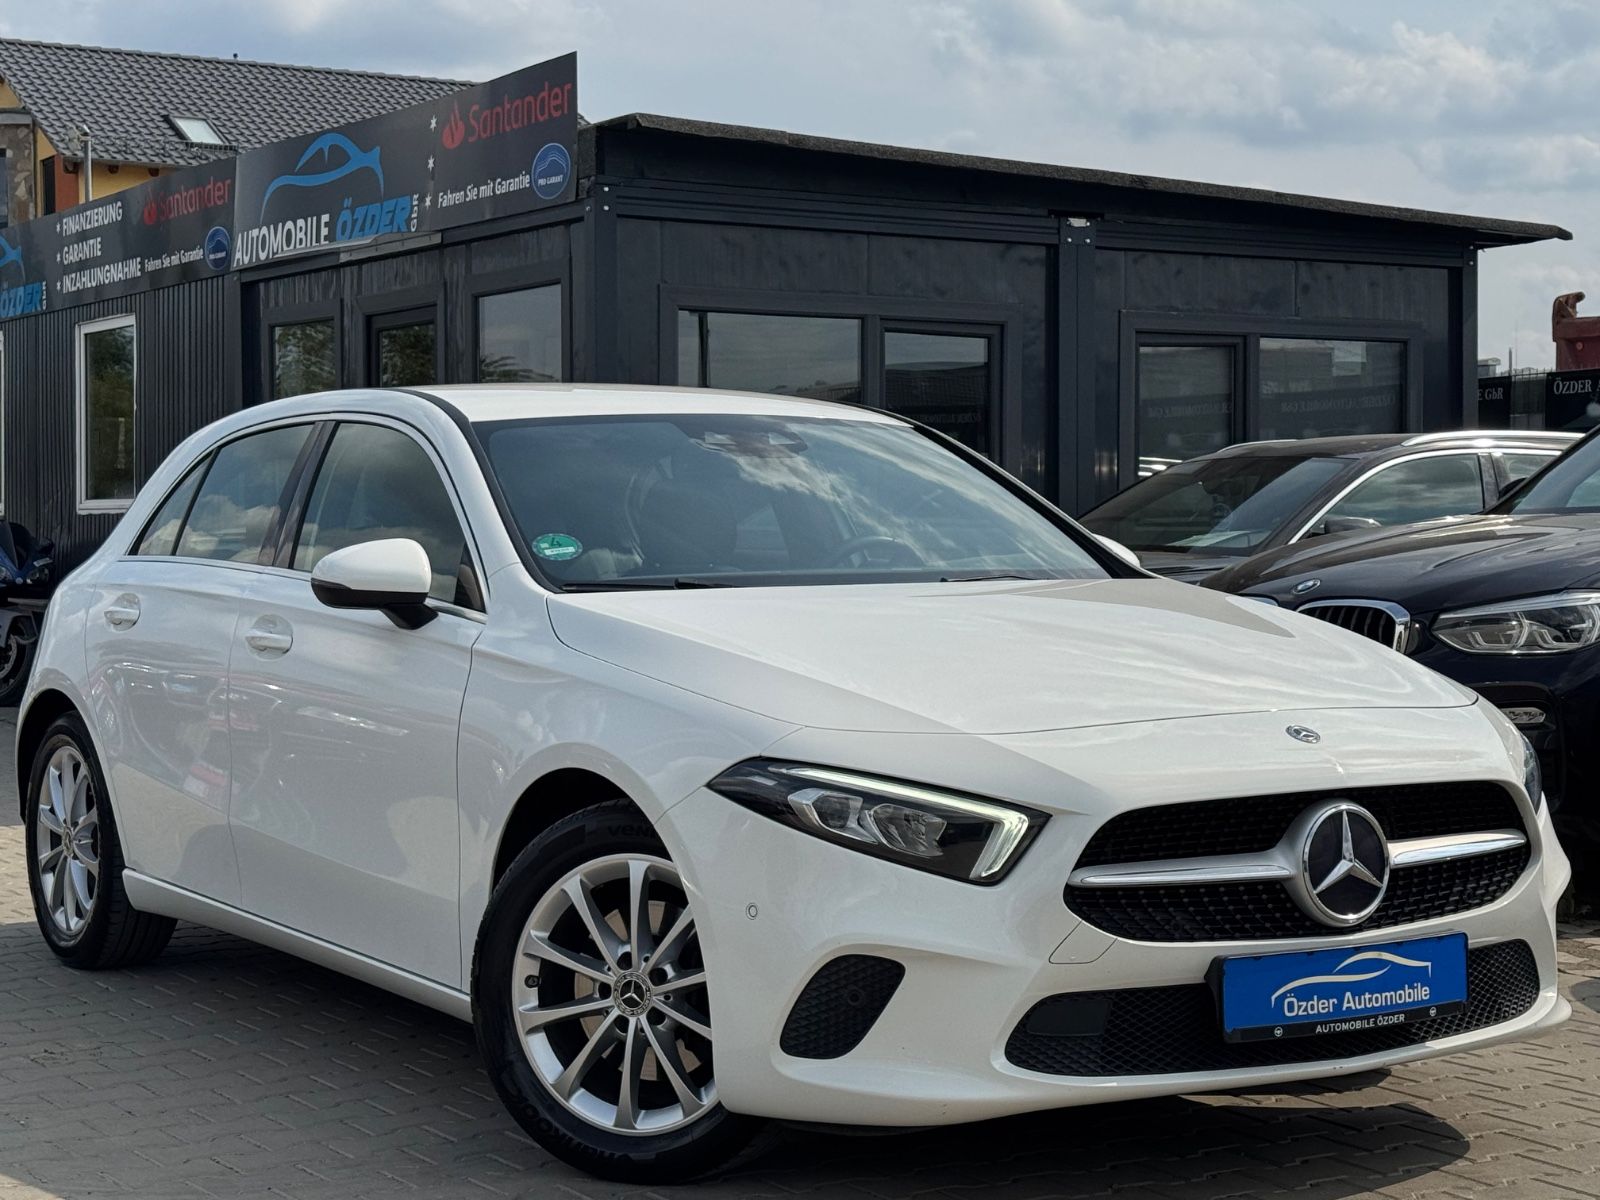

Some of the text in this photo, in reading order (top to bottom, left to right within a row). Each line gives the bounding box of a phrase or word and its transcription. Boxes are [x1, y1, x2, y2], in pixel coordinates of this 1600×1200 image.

[467, 81, 572, 143] Santander
[160, 176, 231, 221] Santander
[438, 171, 531, 208] Fahren Sie mit Garantie
[62, 201, 123, 238] FINANZIERUNG
[410, 193, 420, 232] GbR
[233, 195, 412, 268] AUTOMOBILE ÖZDER
[63, 237, 102, 266] GARANTIE
[144, 257, 162, 273] Fahren
[162, 253, 171, 268] Sie
[170, 251, 181, 266] mit
[180, 245, 204, 264] Garantie
[62, 257, 142, 294] INZAHLUNGNAHME
[1484, 387, 1504, 400] GbR
[1553, 377, 1592, 395] ÖZDER
[1283, 982, 1431, 1017] Özder Automobile
[1315, 1013, 1406, 1034] AUTOMOBILE ÖZDER
